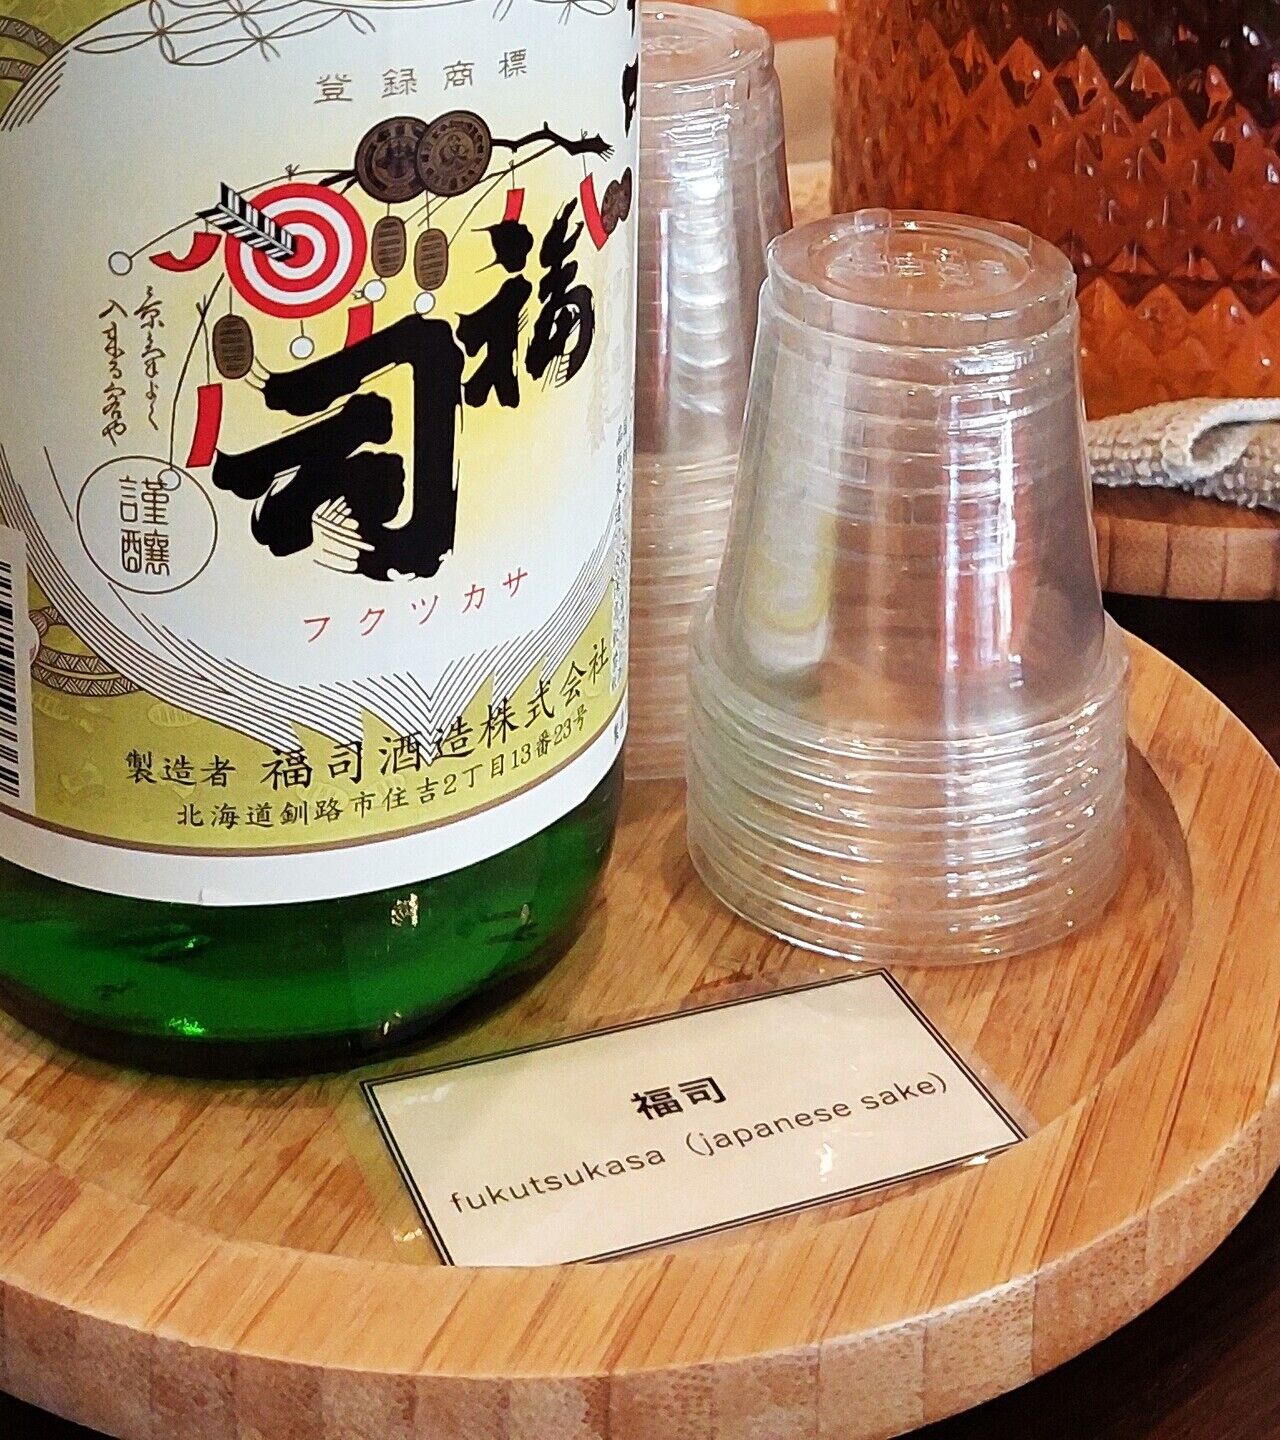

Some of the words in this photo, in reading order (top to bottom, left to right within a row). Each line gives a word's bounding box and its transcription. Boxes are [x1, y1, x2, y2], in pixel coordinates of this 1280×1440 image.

[314, 49, 528, 105] 登録商標
[303, 566, 529, 643] フクツカサ
[125, 748, 237, 789] 製造者
[261, 636, 611, 793] 福司酒造株式会社
[176, 701, 589, 829] 北海道釧路市住吉2丁目13番23号
[449, 1142, 666, 1215] fukutsukasa
[685, 1096, 852, 1158] (japanese
[860, 1070, 949, 1112] sake)
[631, 1075, 728, 1121] 福司
